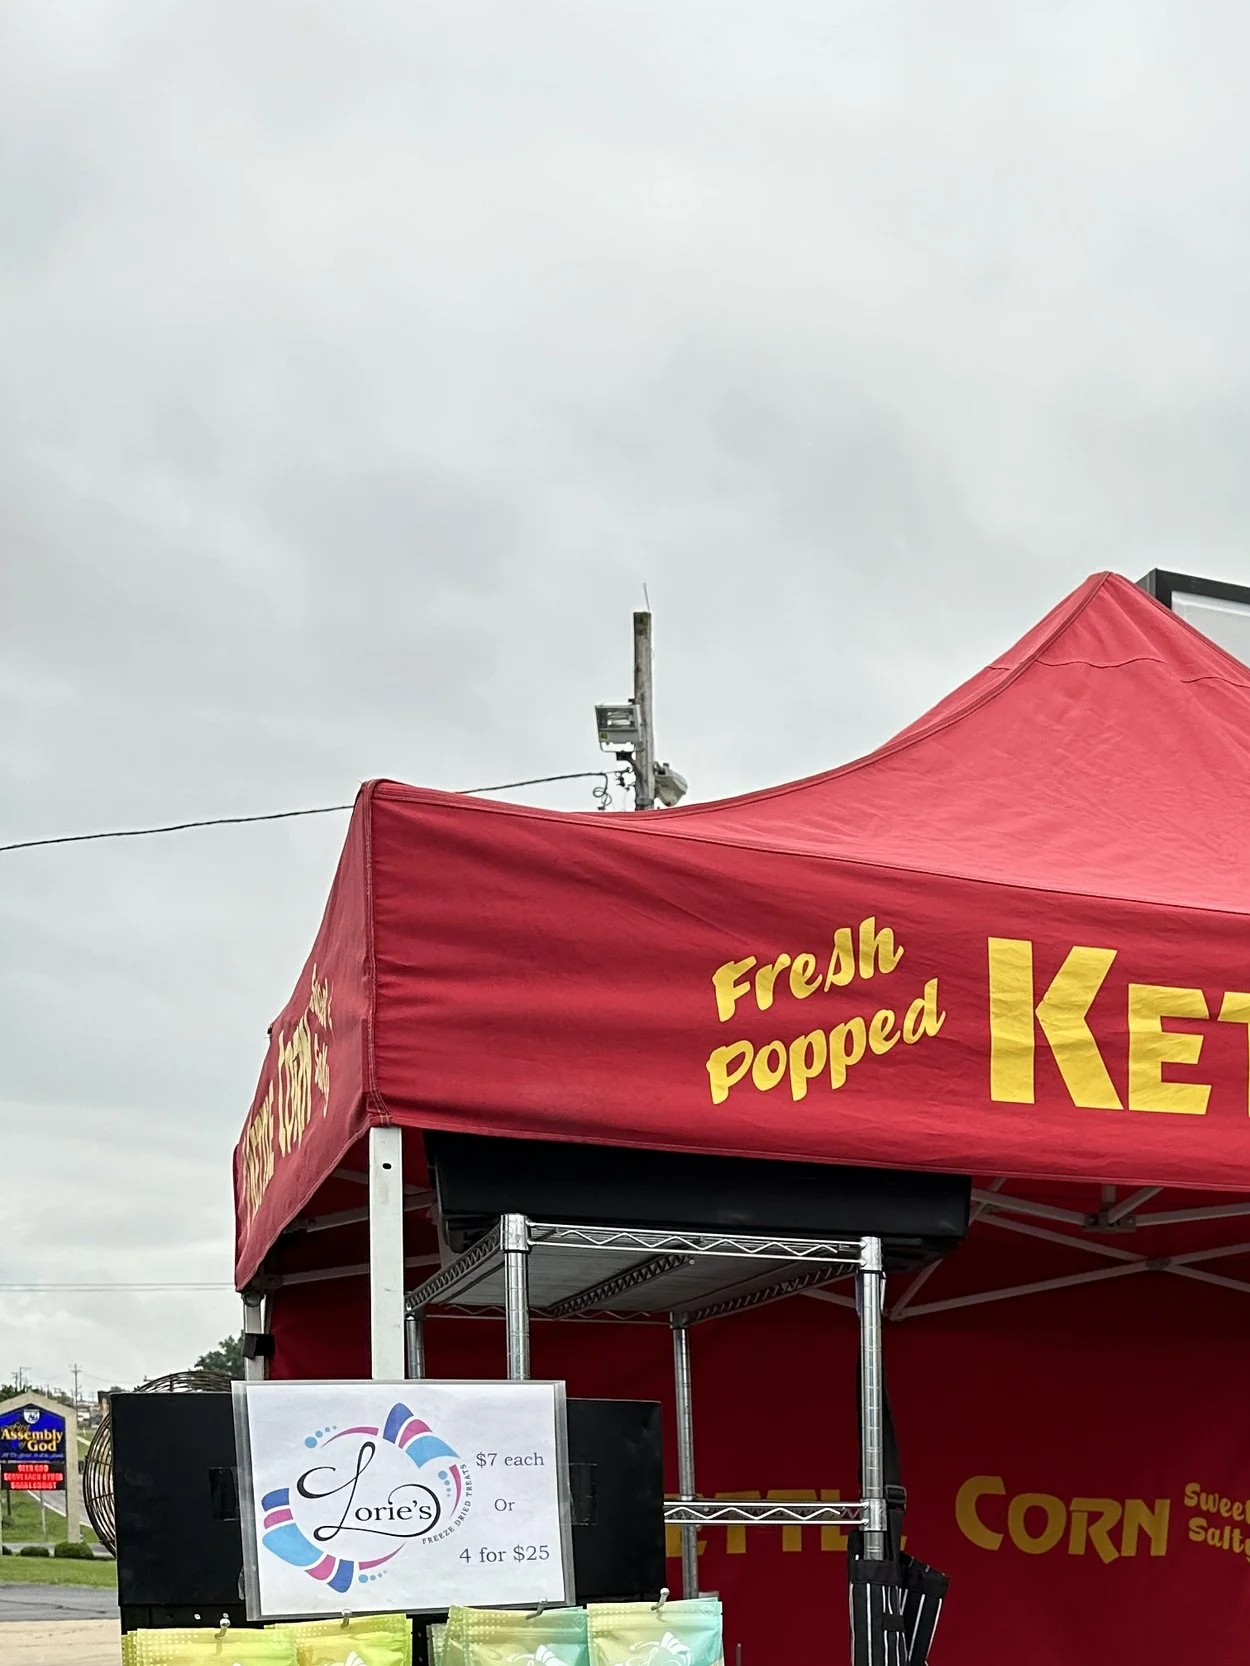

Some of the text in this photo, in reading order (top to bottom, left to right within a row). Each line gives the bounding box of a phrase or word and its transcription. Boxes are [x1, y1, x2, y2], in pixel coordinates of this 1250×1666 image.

[710, 915, 903, 1023] Fresh
[705, 976, 946, 1106] Popped
[1, 1429, 63, 1443] Assembly
[27, 1440, 57, 1451] God
[476, 1453, 545, 1468] $7 each
[297, 1441, 441, 1541] Lorie's
[422, 1464, 472, 1545] FREEZE DRIED TREATS
[494, 1499, 515, 1512] Or
[955, 1475, 1170, 1564] CORN
[459, 1545, 550, 1563] 4 for $25
